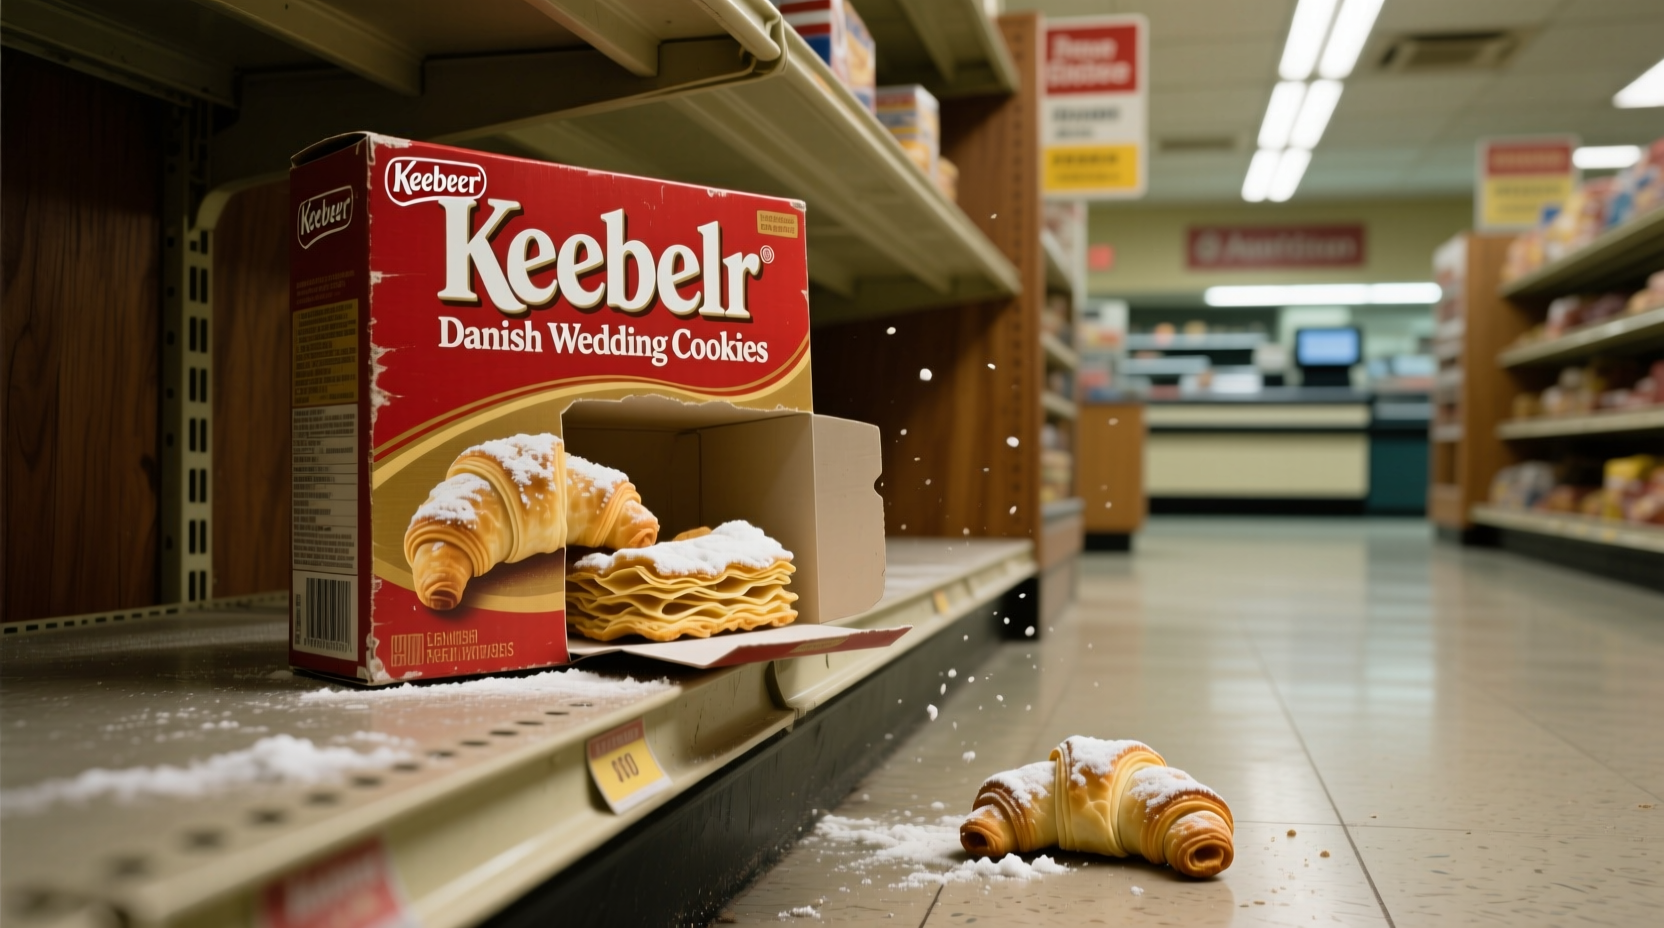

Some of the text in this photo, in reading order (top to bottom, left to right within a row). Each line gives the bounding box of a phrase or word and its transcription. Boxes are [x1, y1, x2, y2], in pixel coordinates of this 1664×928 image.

[393, 160, 481, 195] Keebeer
[437, 198, 762, 319] Keebelr
[438, 316, 768, 367] Danish Wedding Cookies
